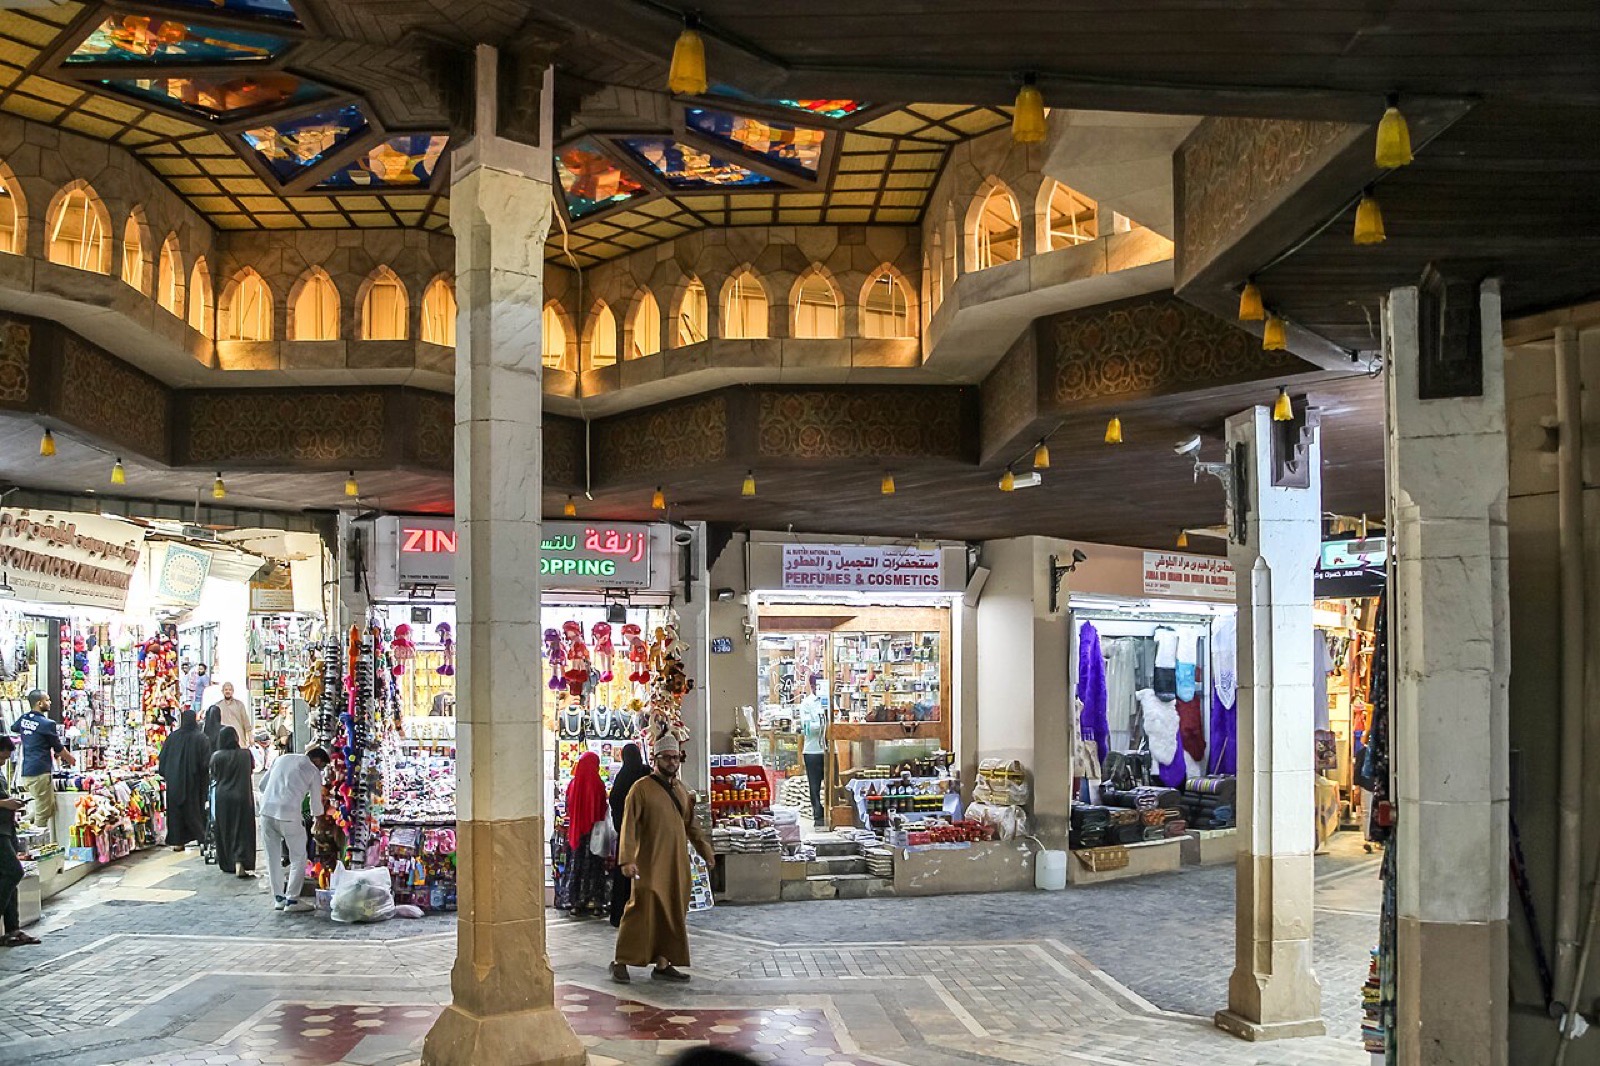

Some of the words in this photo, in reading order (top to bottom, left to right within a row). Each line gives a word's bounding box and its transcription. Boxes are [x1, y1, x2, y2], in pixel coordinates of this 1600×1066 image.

[403, 529, 457, 552] ZIN
[540, 534, 576, 550] للتس
[585, 528, 645, 562] زنقة
[540, 559, 616, 576] OPPING
[784, 555, 824, 570] العطور
[826, 559, 833, 571] و
[835, 556, 879, 571] التجميل
[882, 558, 939, 571] مستحضرات
[785, 572, 852, 585] PERFUMES
[855, 573, 865, 585] &
[868, 573, 939, 586] COSMETICS
